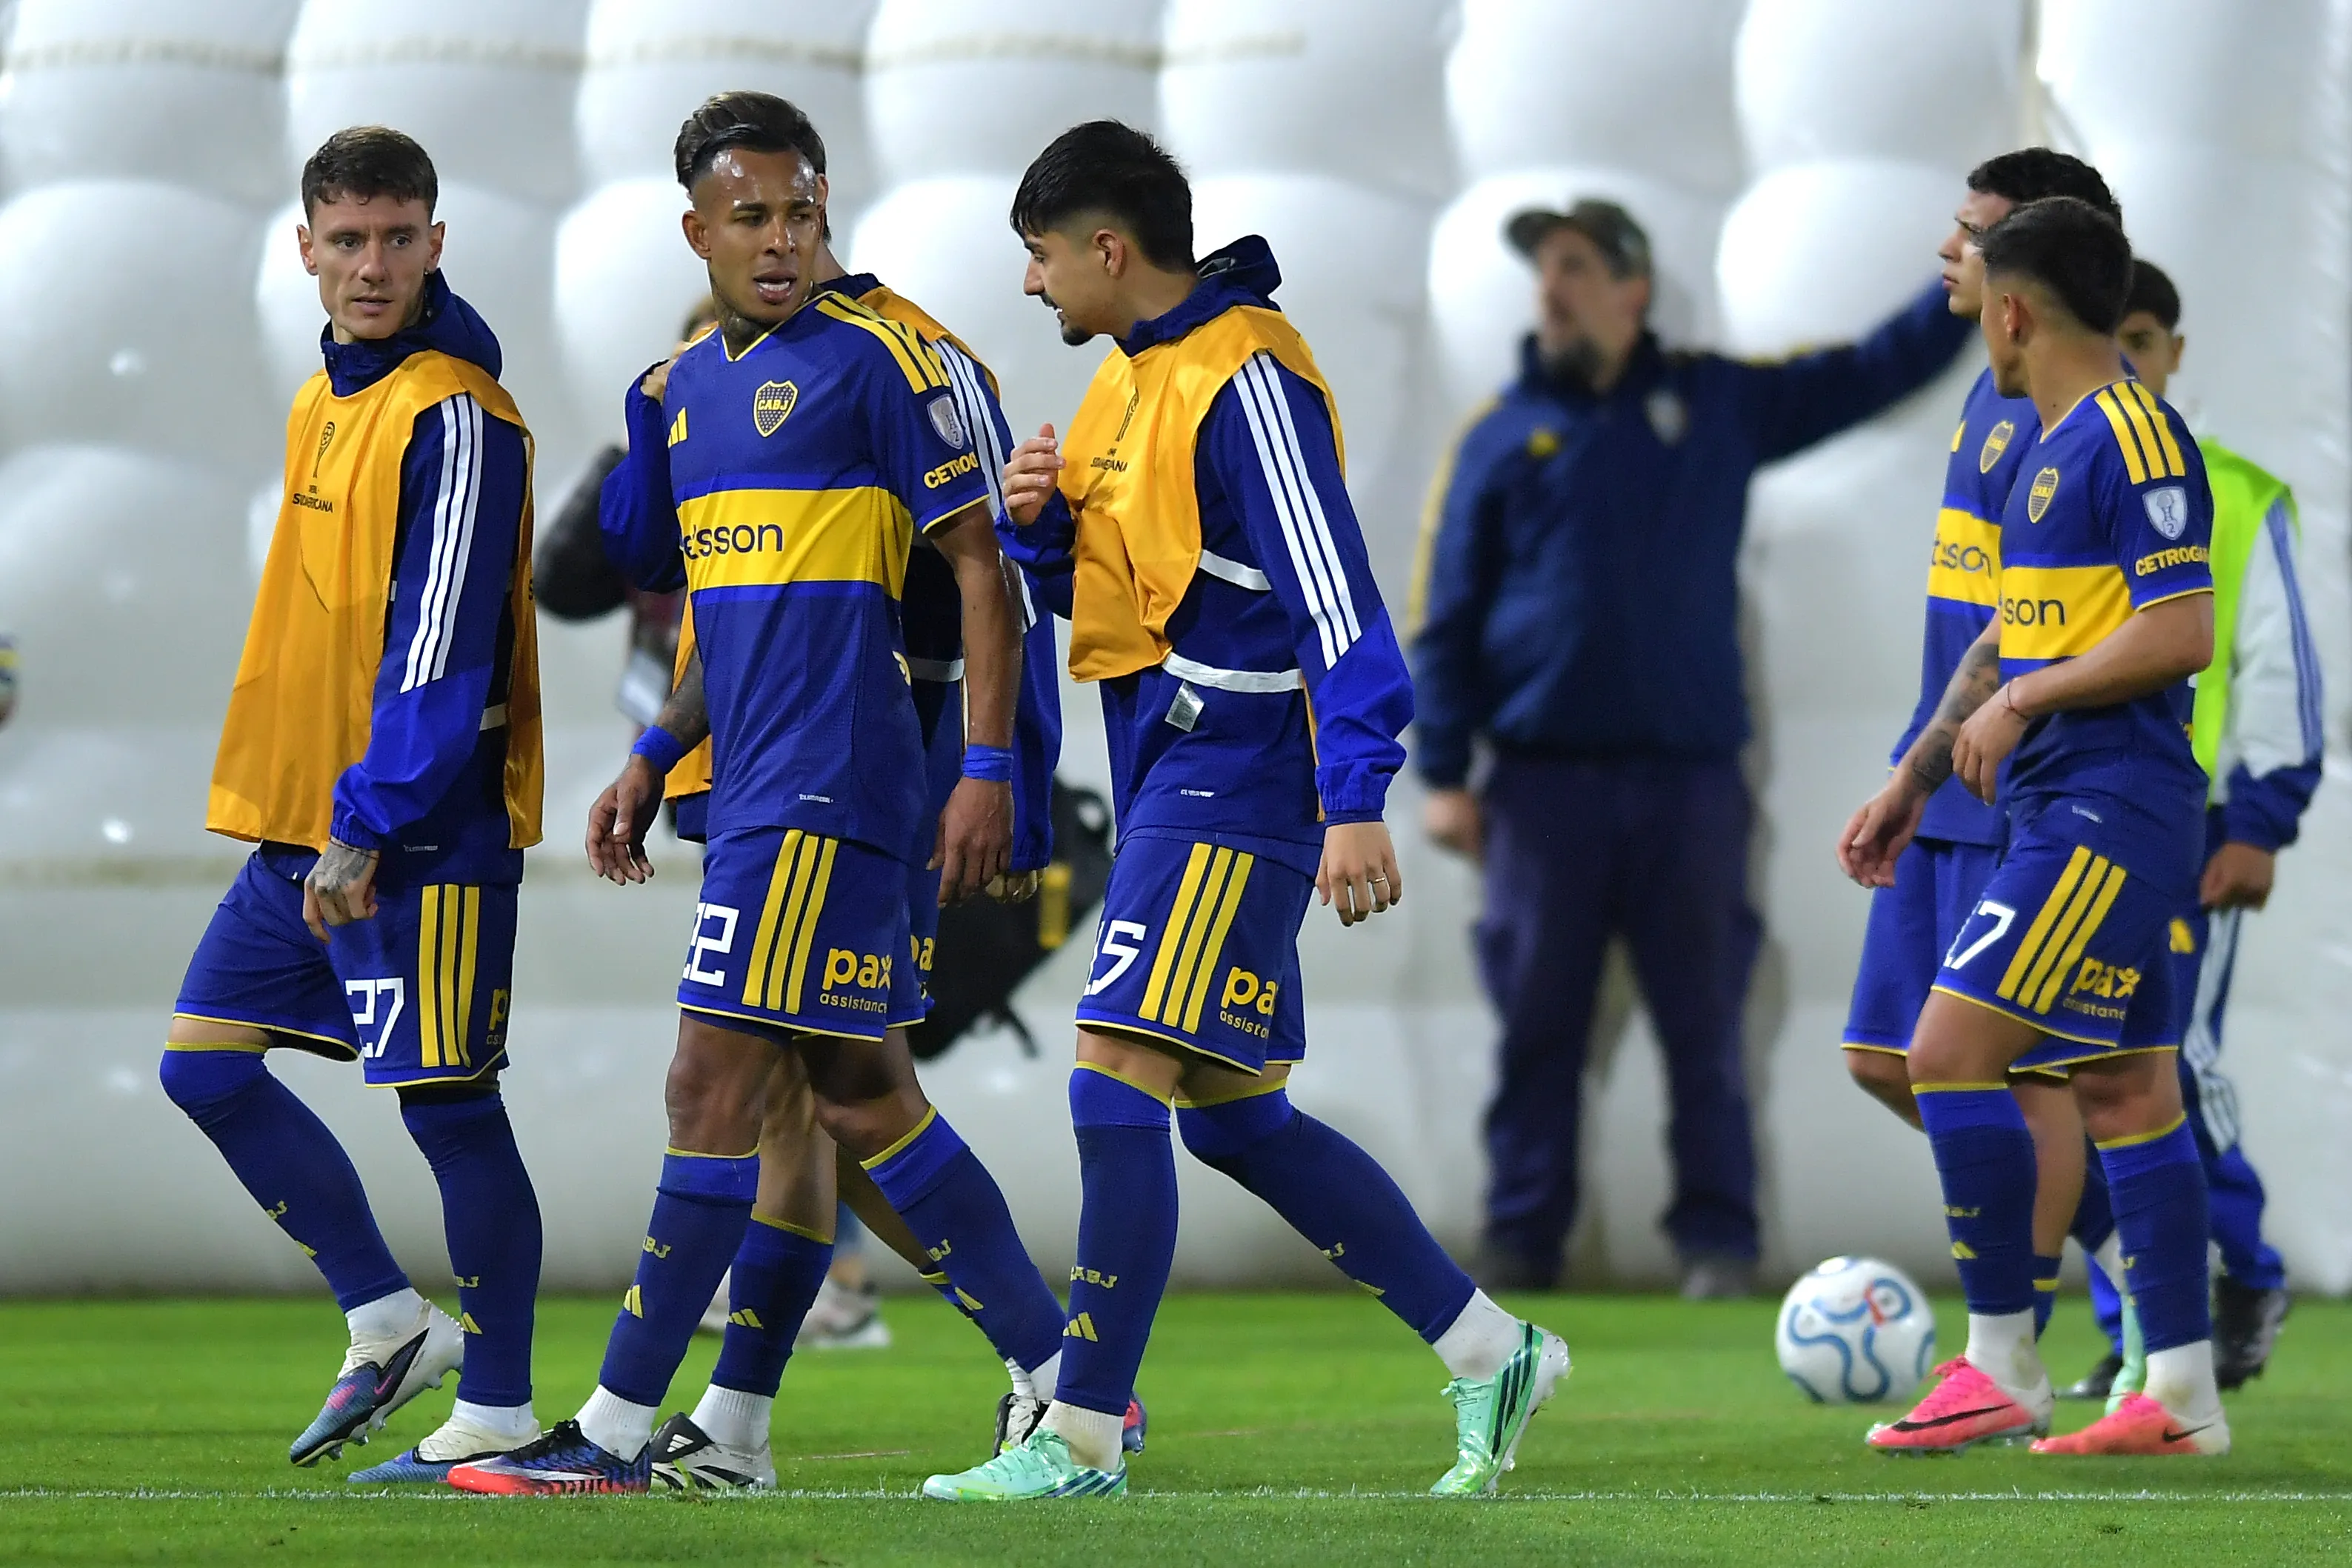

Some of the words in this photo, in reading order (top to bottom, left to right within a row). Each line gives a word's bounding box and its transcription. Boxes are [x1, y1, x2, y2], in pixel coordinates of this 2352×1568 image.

[757, 398, 789, 411] CABJ
[1999, 598, 2065, 627] son
[1221, 966, 1279, 1016] pa
